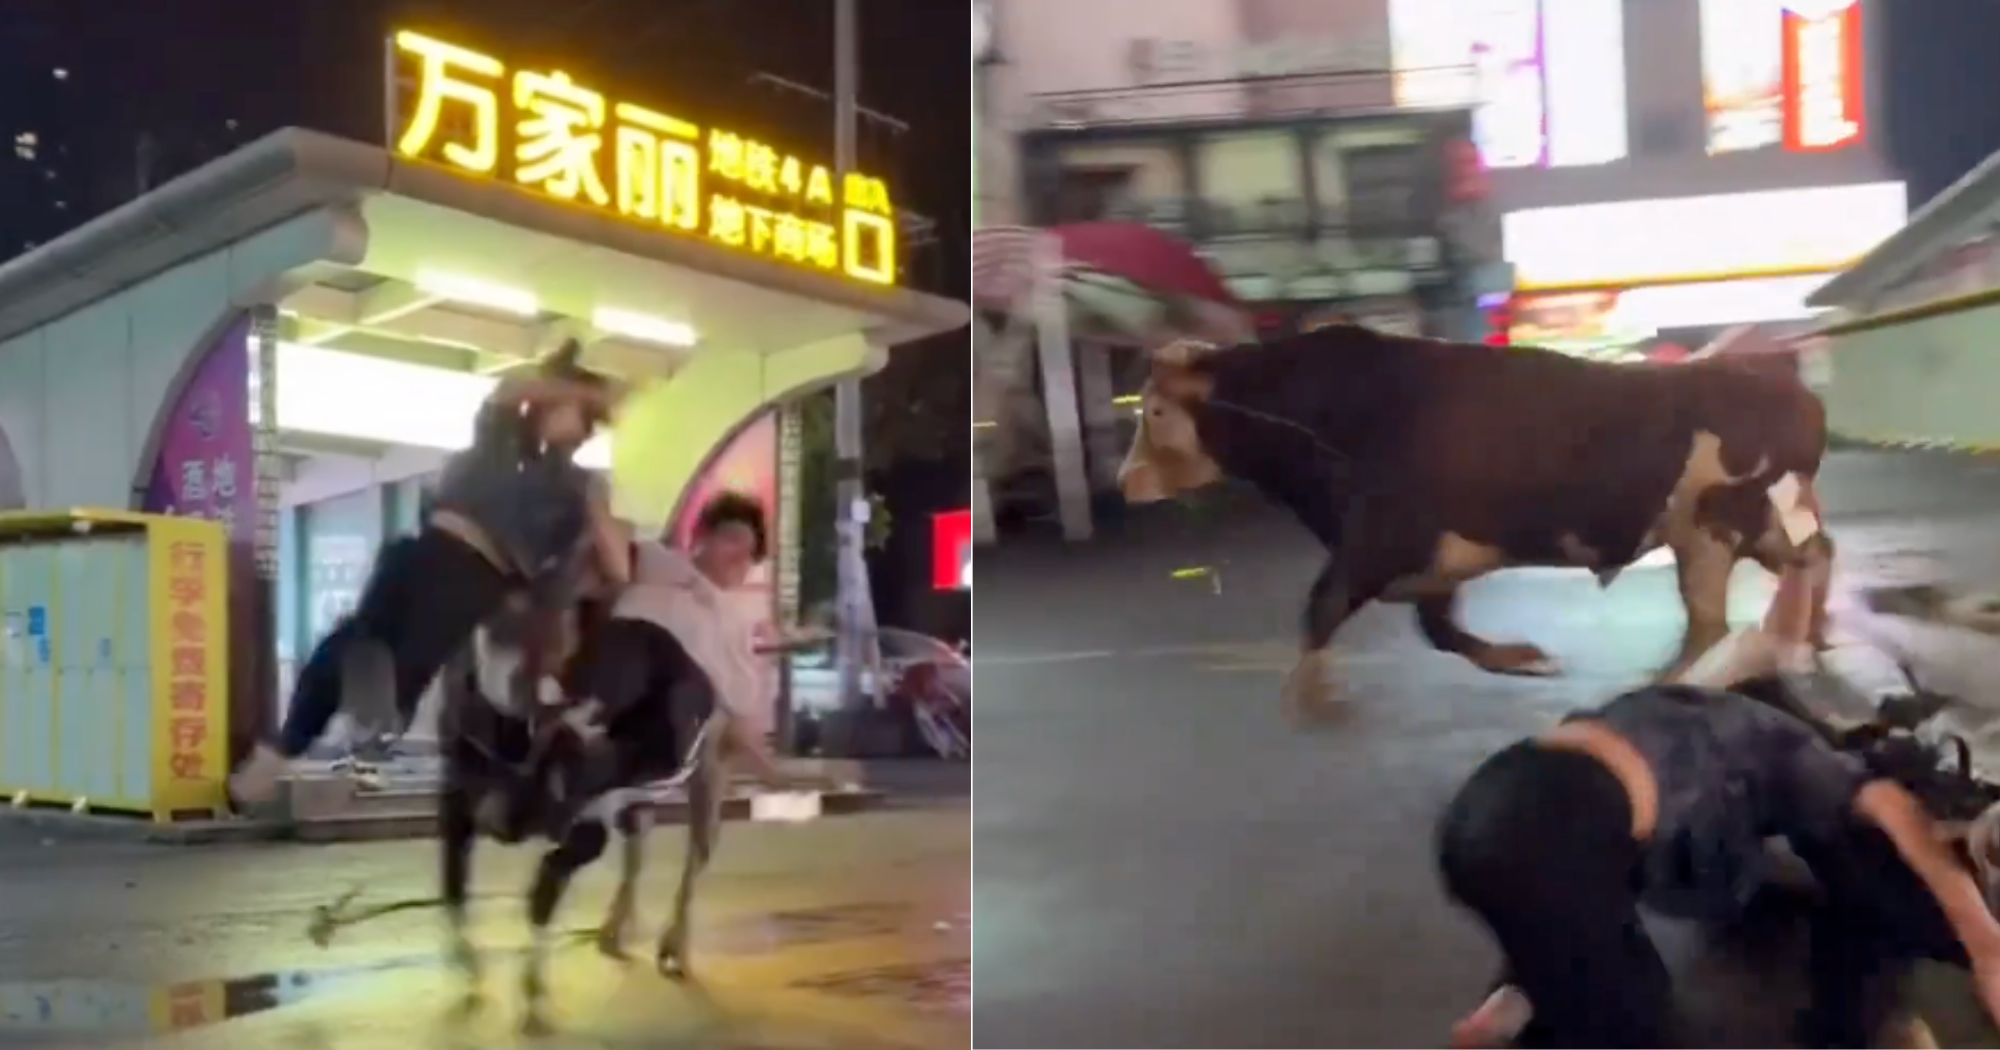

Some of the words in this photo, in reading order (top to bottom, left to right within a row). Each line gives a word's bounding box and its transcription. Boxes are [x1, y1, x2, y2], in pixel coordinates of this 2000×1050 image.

[397, 30, 702, 230] 万家丽
[708, 193, 838, 270] 地下商场
